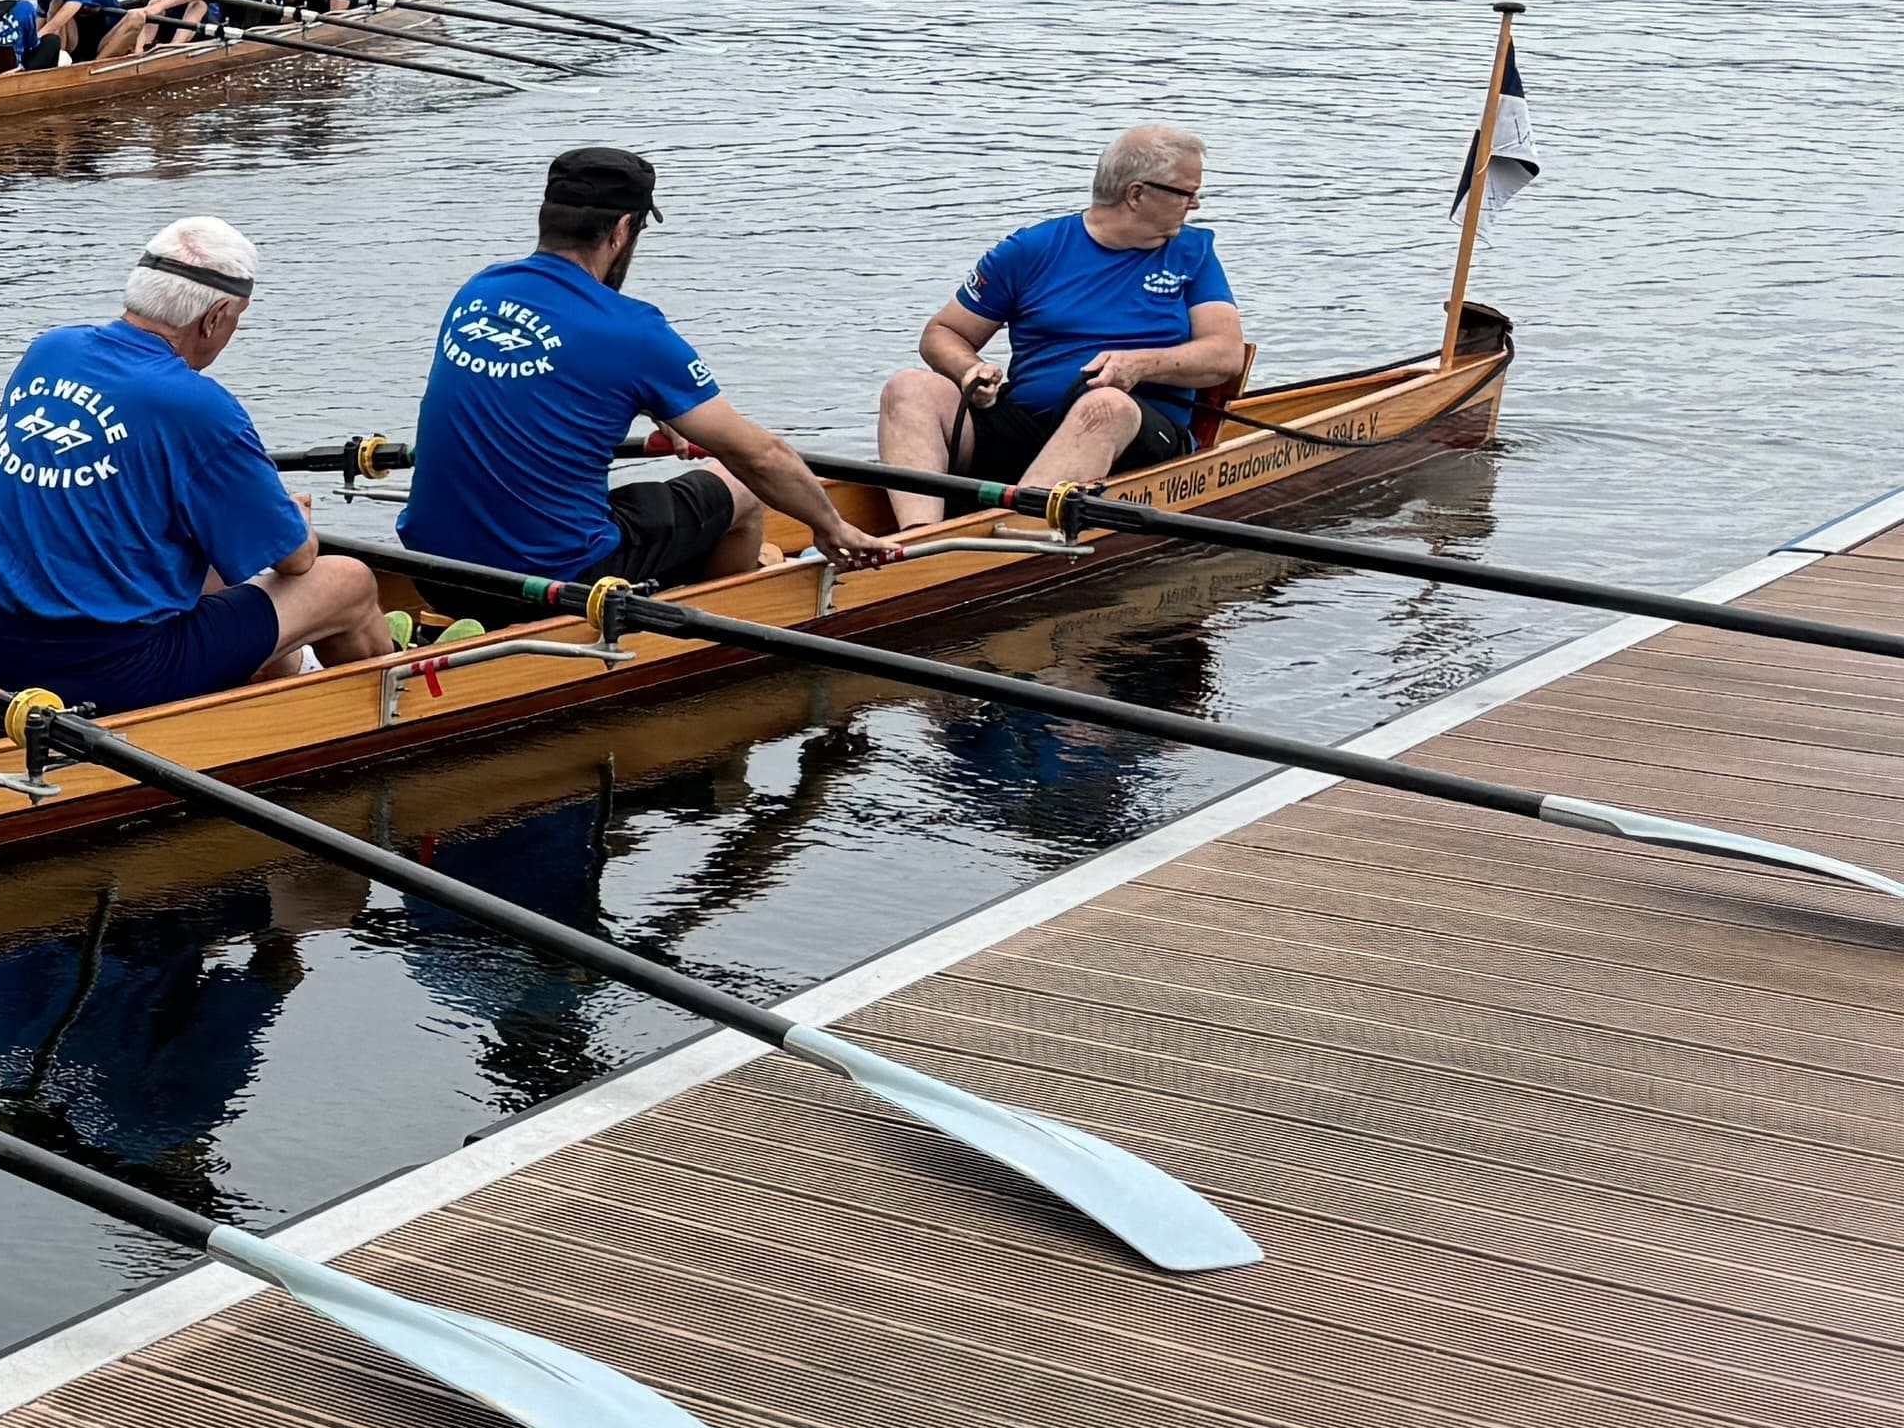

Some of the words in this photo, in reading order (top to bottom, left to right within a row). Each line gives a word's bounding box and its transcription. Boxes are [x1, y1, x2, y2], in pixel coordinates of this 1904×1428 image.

[498, 300, 562, 351] WELLE
[53, 378, 128, 444] WELLE
[1217, 440, 1293, 489] Bardowick
